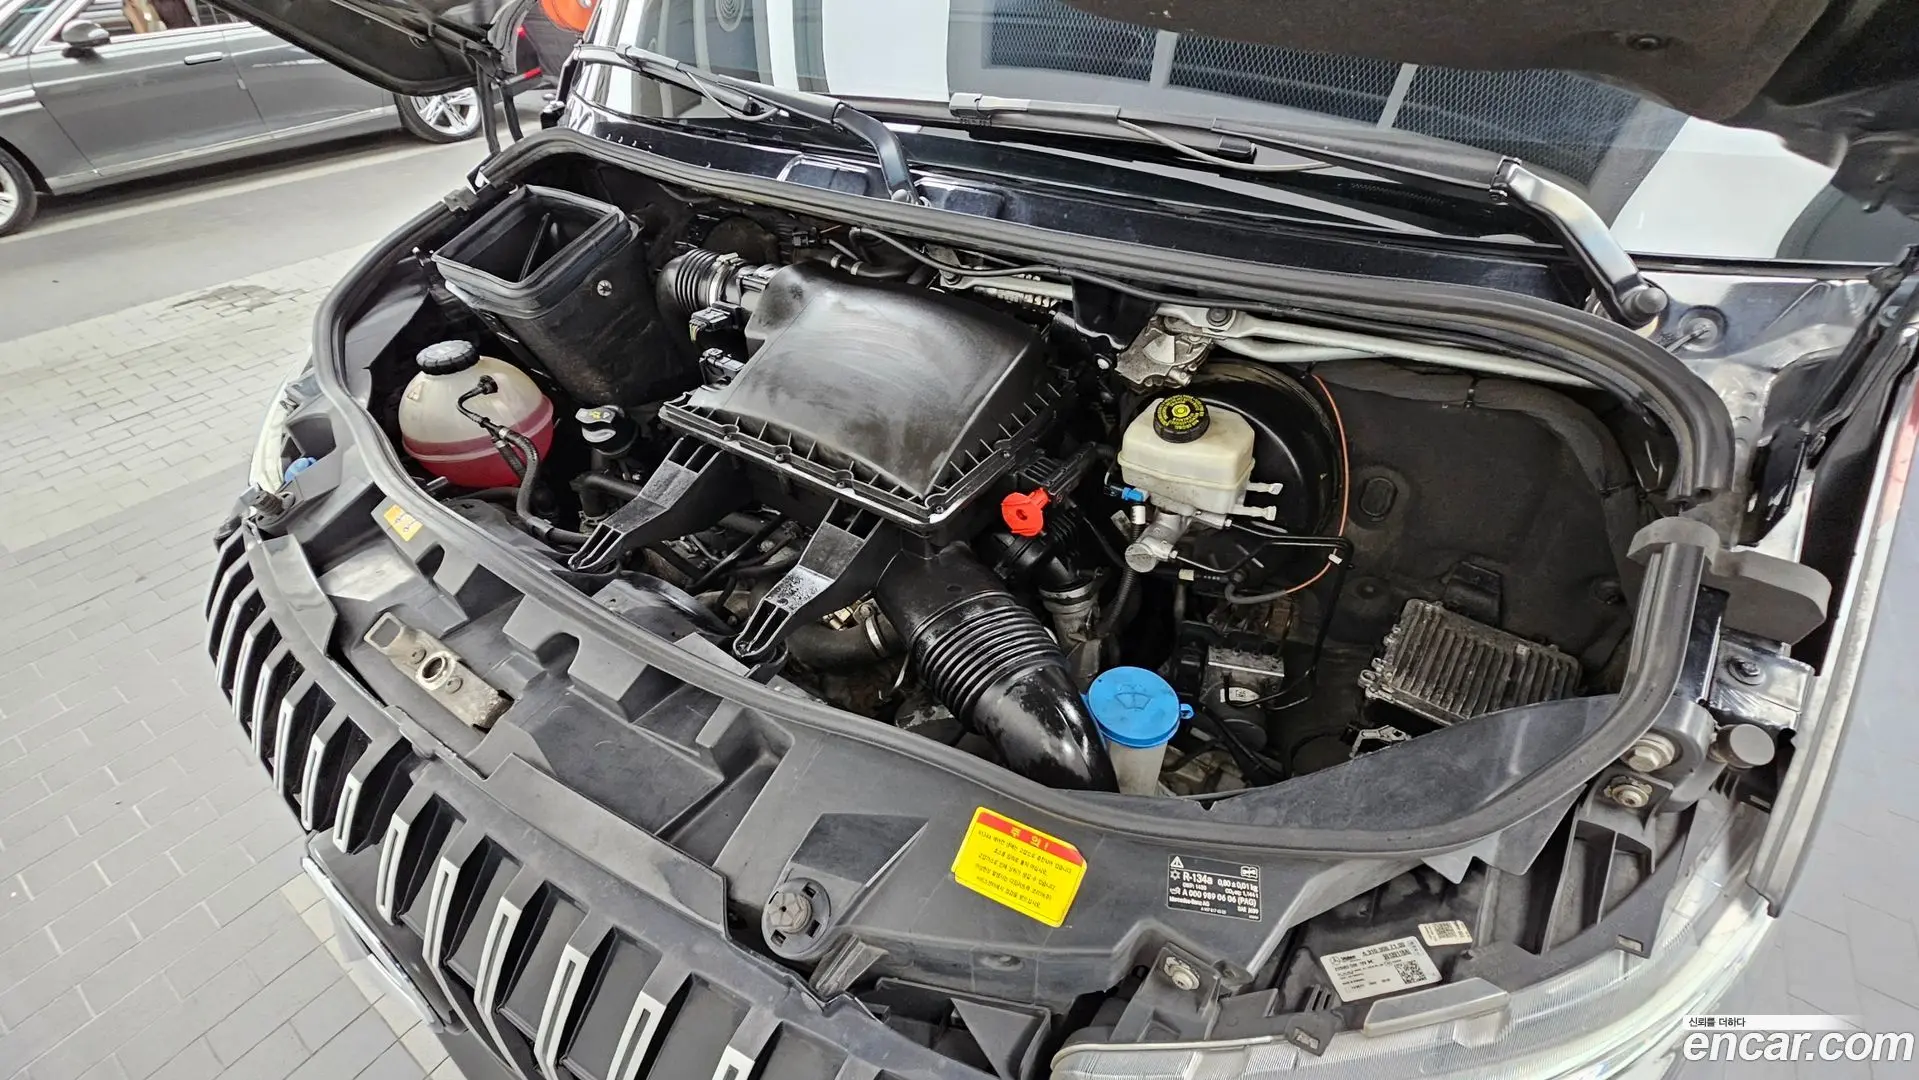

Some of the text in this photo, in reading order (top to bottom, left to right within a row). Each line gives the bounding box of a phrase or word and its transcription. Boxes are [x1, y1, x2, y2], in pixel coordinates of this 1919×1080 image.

[1010, 827, 1021, 838] 주
[1183, 872, 1213, 885] R-134a
[1189, 890, 1202, 898] 000
[1203, 892, 1216, 900] 989
[1217, 894, 1226, 902] 06
[1227, 895, 1236, 903] 06
